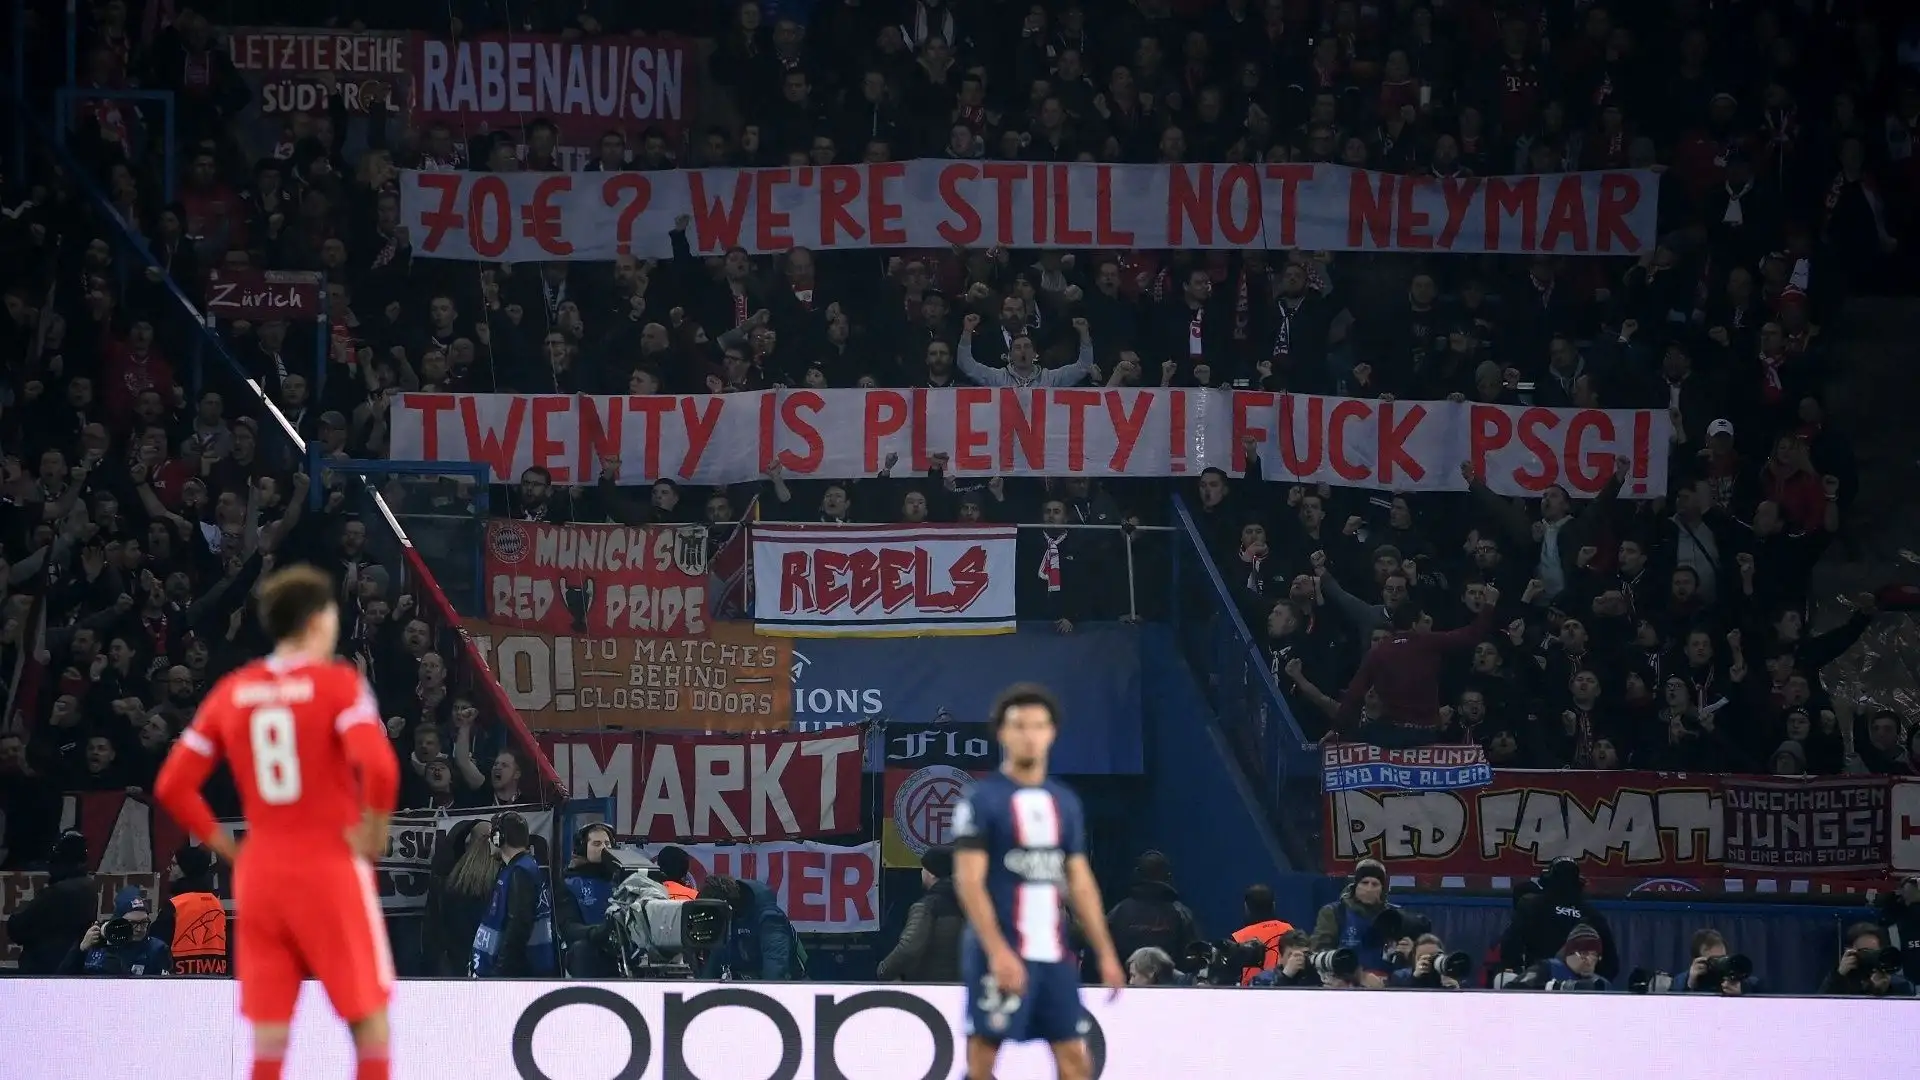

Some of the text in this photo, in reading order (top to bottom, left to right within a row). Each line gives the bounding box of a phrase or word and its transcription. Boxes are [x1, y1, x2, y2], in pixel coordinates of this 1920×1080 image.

[229, 33, 330, 70] LETZTE
[423, 39, 683, 120] RABENAU/SN
[601, 172, 652, 256] ?
[688, 162, 907, 252] WE'RE
[935, 162, 1135, 245] STILL
[1167, 162, 1315, 246] NOT
[1346, 169, 1642, 252] NEYMAR
[208, 282, 302, 308] Zürich
[403, 387, 1652, 494] TWENTY IS PLENTY! FUCK PSG!
[779, 544, 990, 615] REBELS
[492, 574, 706, 634] RED PRIDE
[580, 638, 777, 668] TO MATCHES
[628, 664, 728, 690] BEHIND
[579, 687, 773, 715] CLOSED DOORS
[250, 706, 303, 806] 8
[1725, 787, 1886, 811] DURCHHALTEN
[1331, 789, 1469, 861] RED
[1727, 809, 1884, 849] JUNGS!
[1728, 847, 1746, 861] NO
[1784, 850, 1812, 864] CAN
[1817, 849, 1857, 862] STOP
[1861, 846, 1881, 861] US
